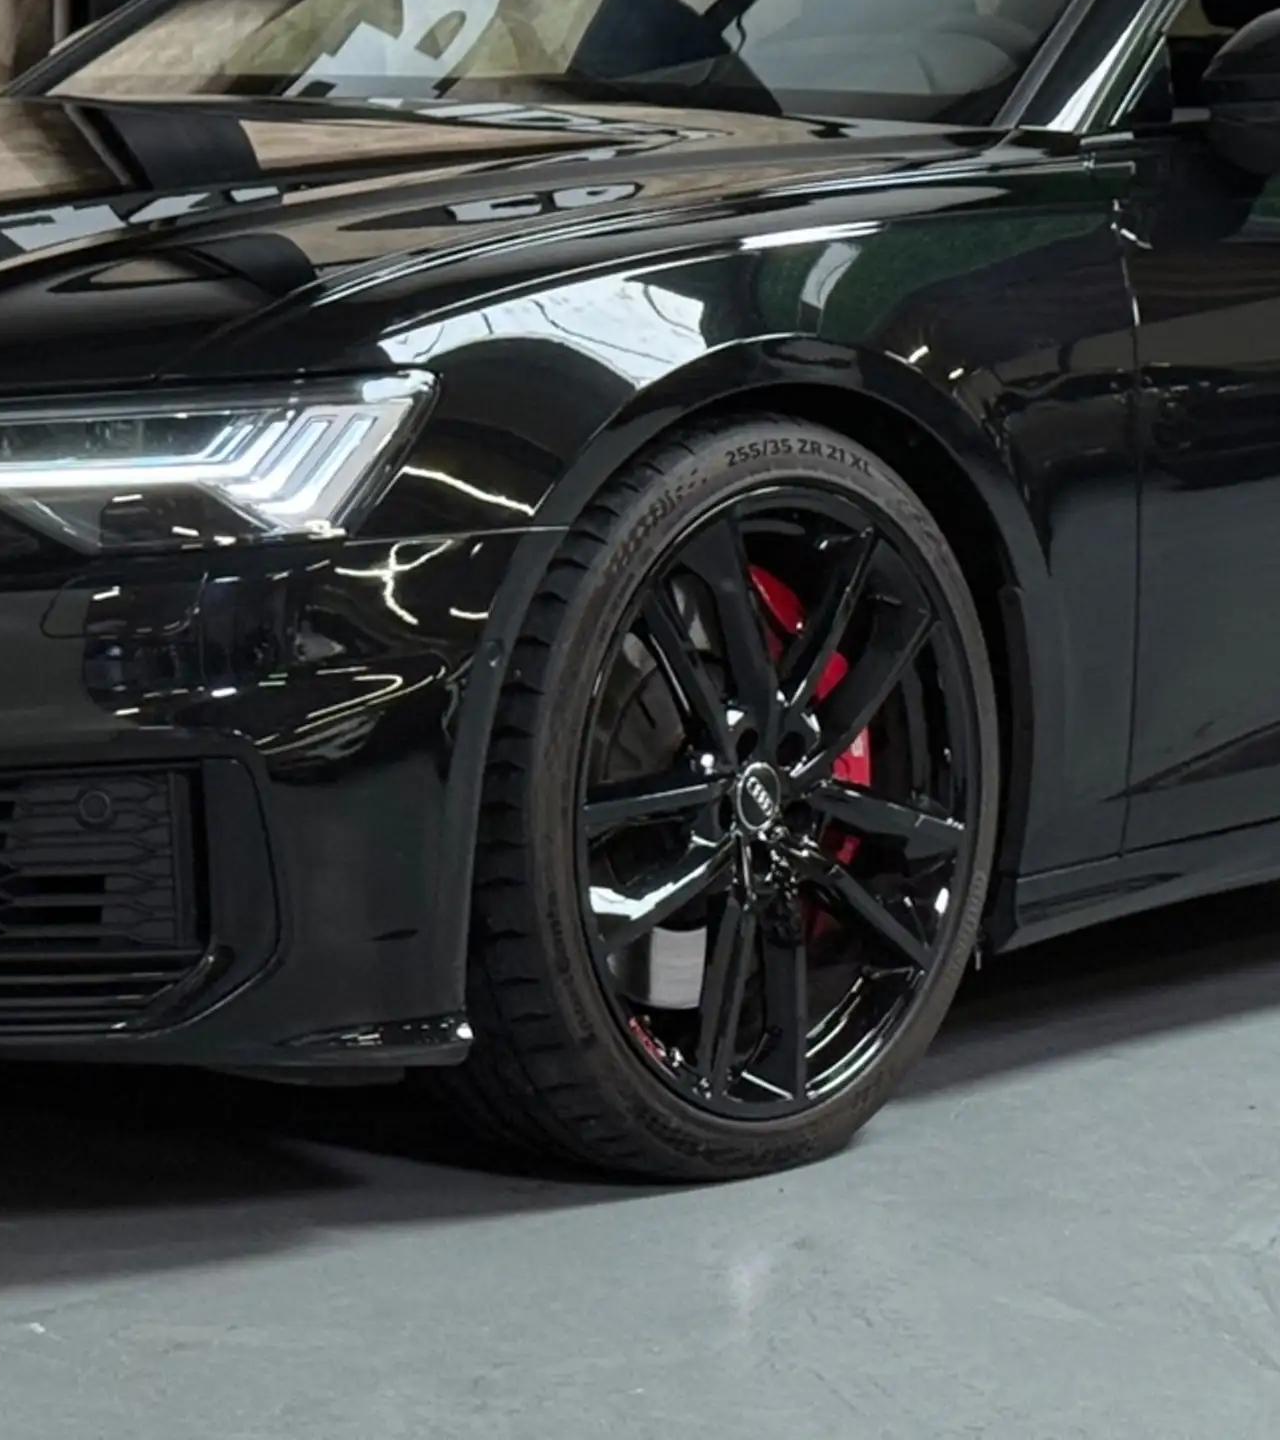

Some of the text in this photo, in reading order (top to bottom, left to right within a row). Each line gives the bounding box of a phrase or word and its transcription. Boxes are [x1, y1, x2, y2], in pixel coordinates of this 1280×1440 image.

[724, 438, 793, 467] 255/35
[797, 438, 823, 458] ZR
[826, 443, 846, 463] 21
